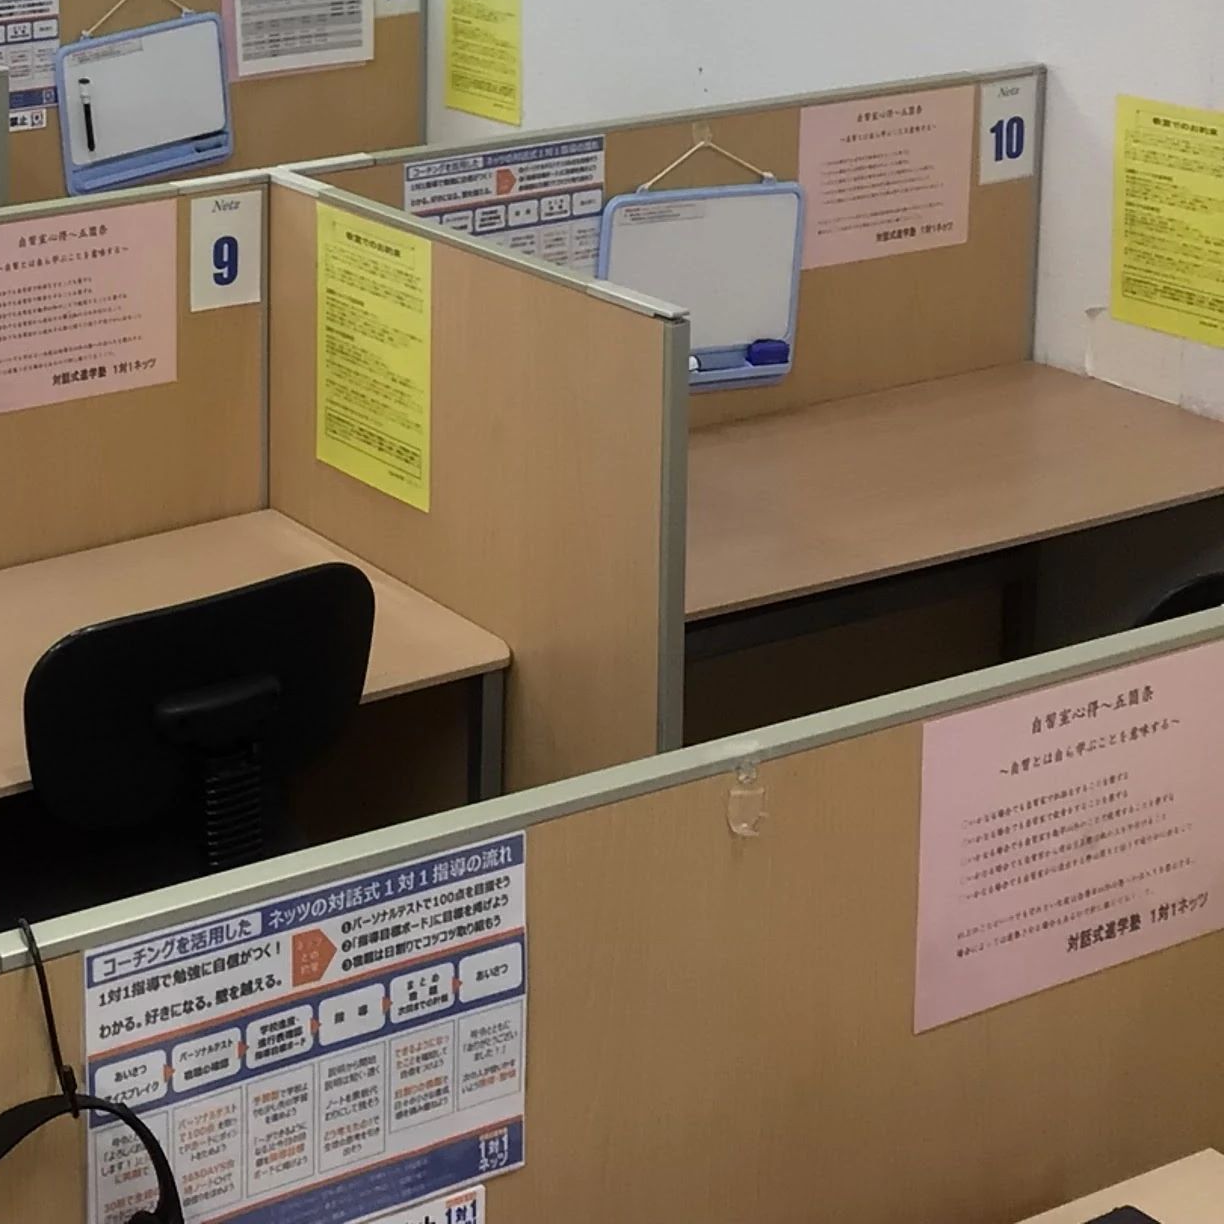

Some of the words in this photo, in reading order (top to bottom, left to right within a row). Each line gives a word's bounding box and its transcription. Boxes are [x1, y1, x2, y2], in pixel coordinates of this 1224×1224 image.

[990, 115, 1025, 162] 10
[213, 236, 238, 286] 9
[1150, 892, 1209, 924] 1対1ネッツ
[103, 919, 252, 977] コーチングを活用した
